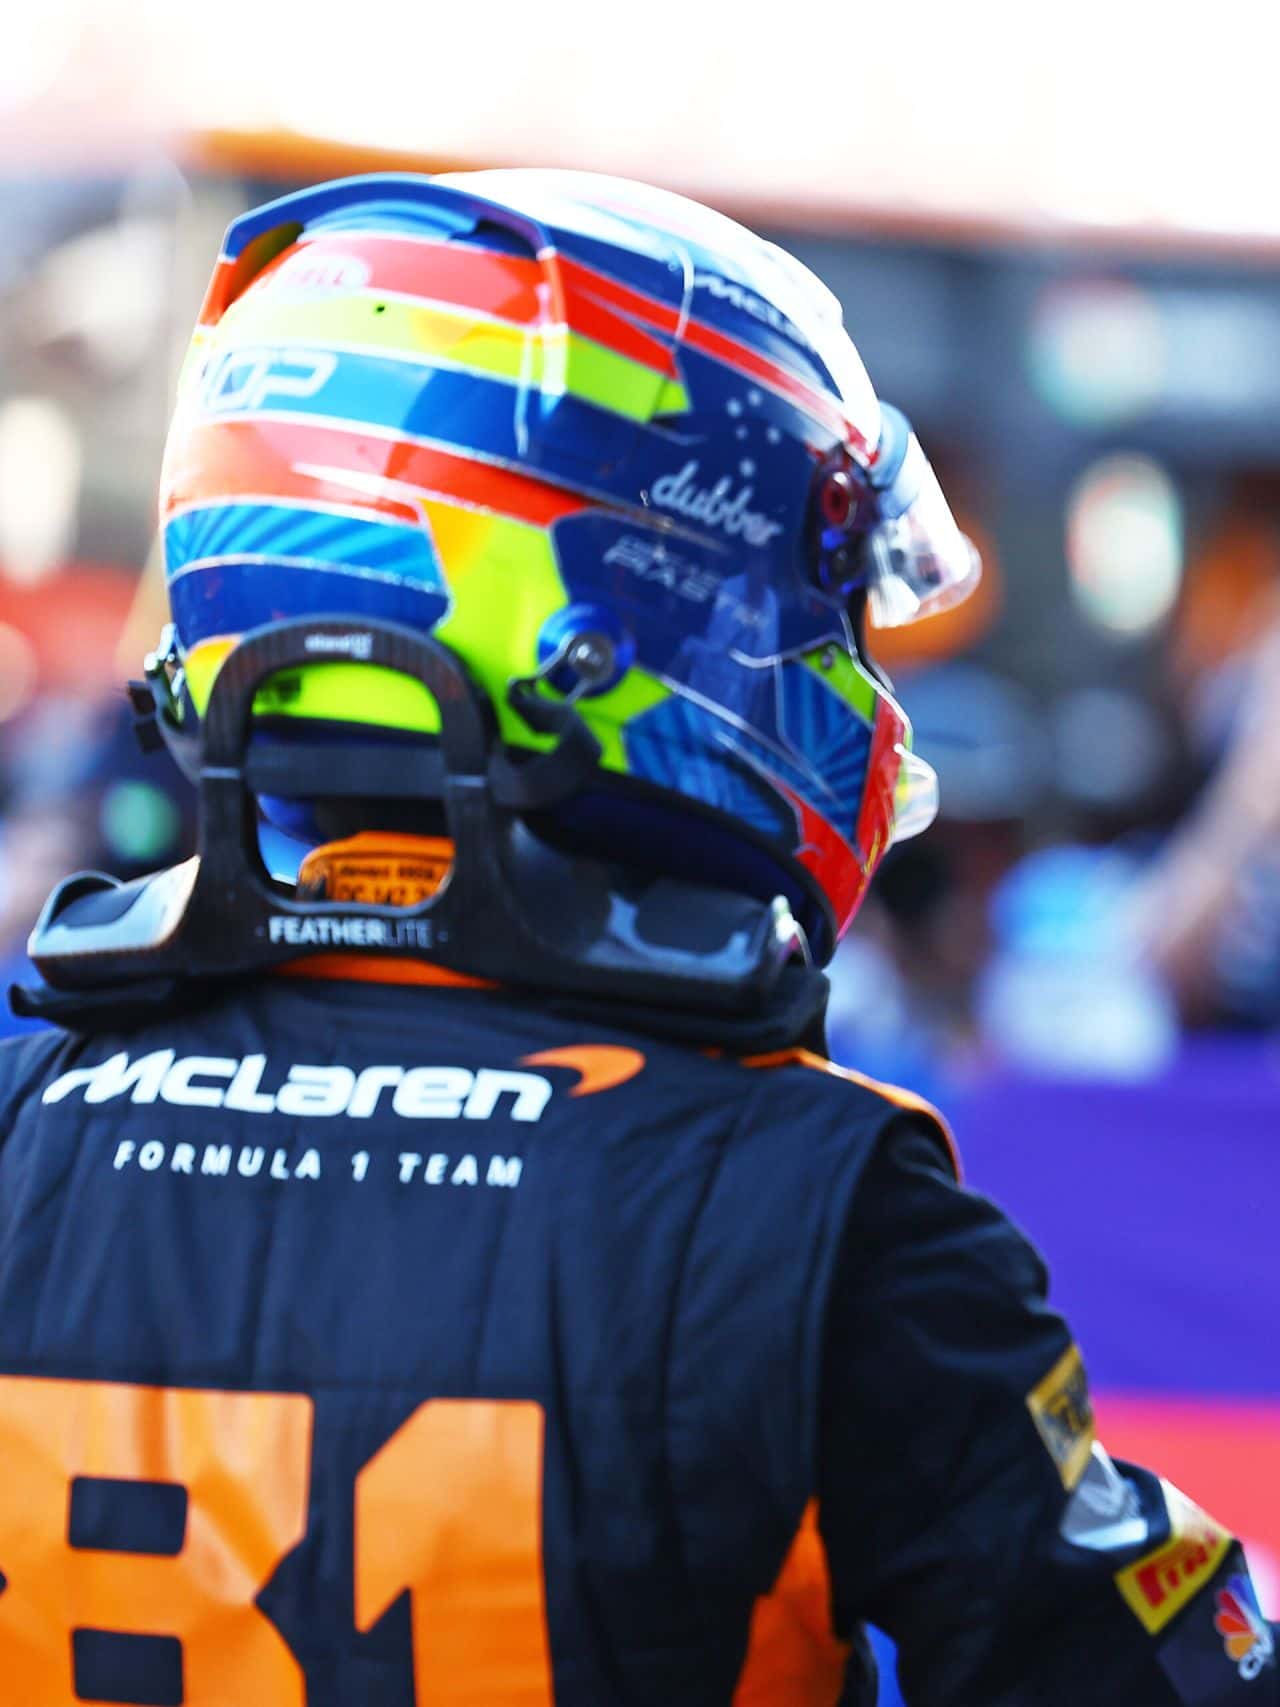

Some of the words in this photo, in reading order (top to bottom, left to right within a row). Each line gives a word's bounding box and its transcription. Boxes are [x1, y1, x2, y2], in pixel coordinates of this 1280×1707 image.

[651, 460, 782, 546] dubber
[268, 916, 433, 948] FEATHERLITE
[42, 1049, 552, 1122] McLaren
[113, 1140, 321, 1181] FORMULA
[352, 1151, 368, 1182] 1
[399, 1153, 523, 1187] TEAM
[0, 1374, 556, 1707] 81
